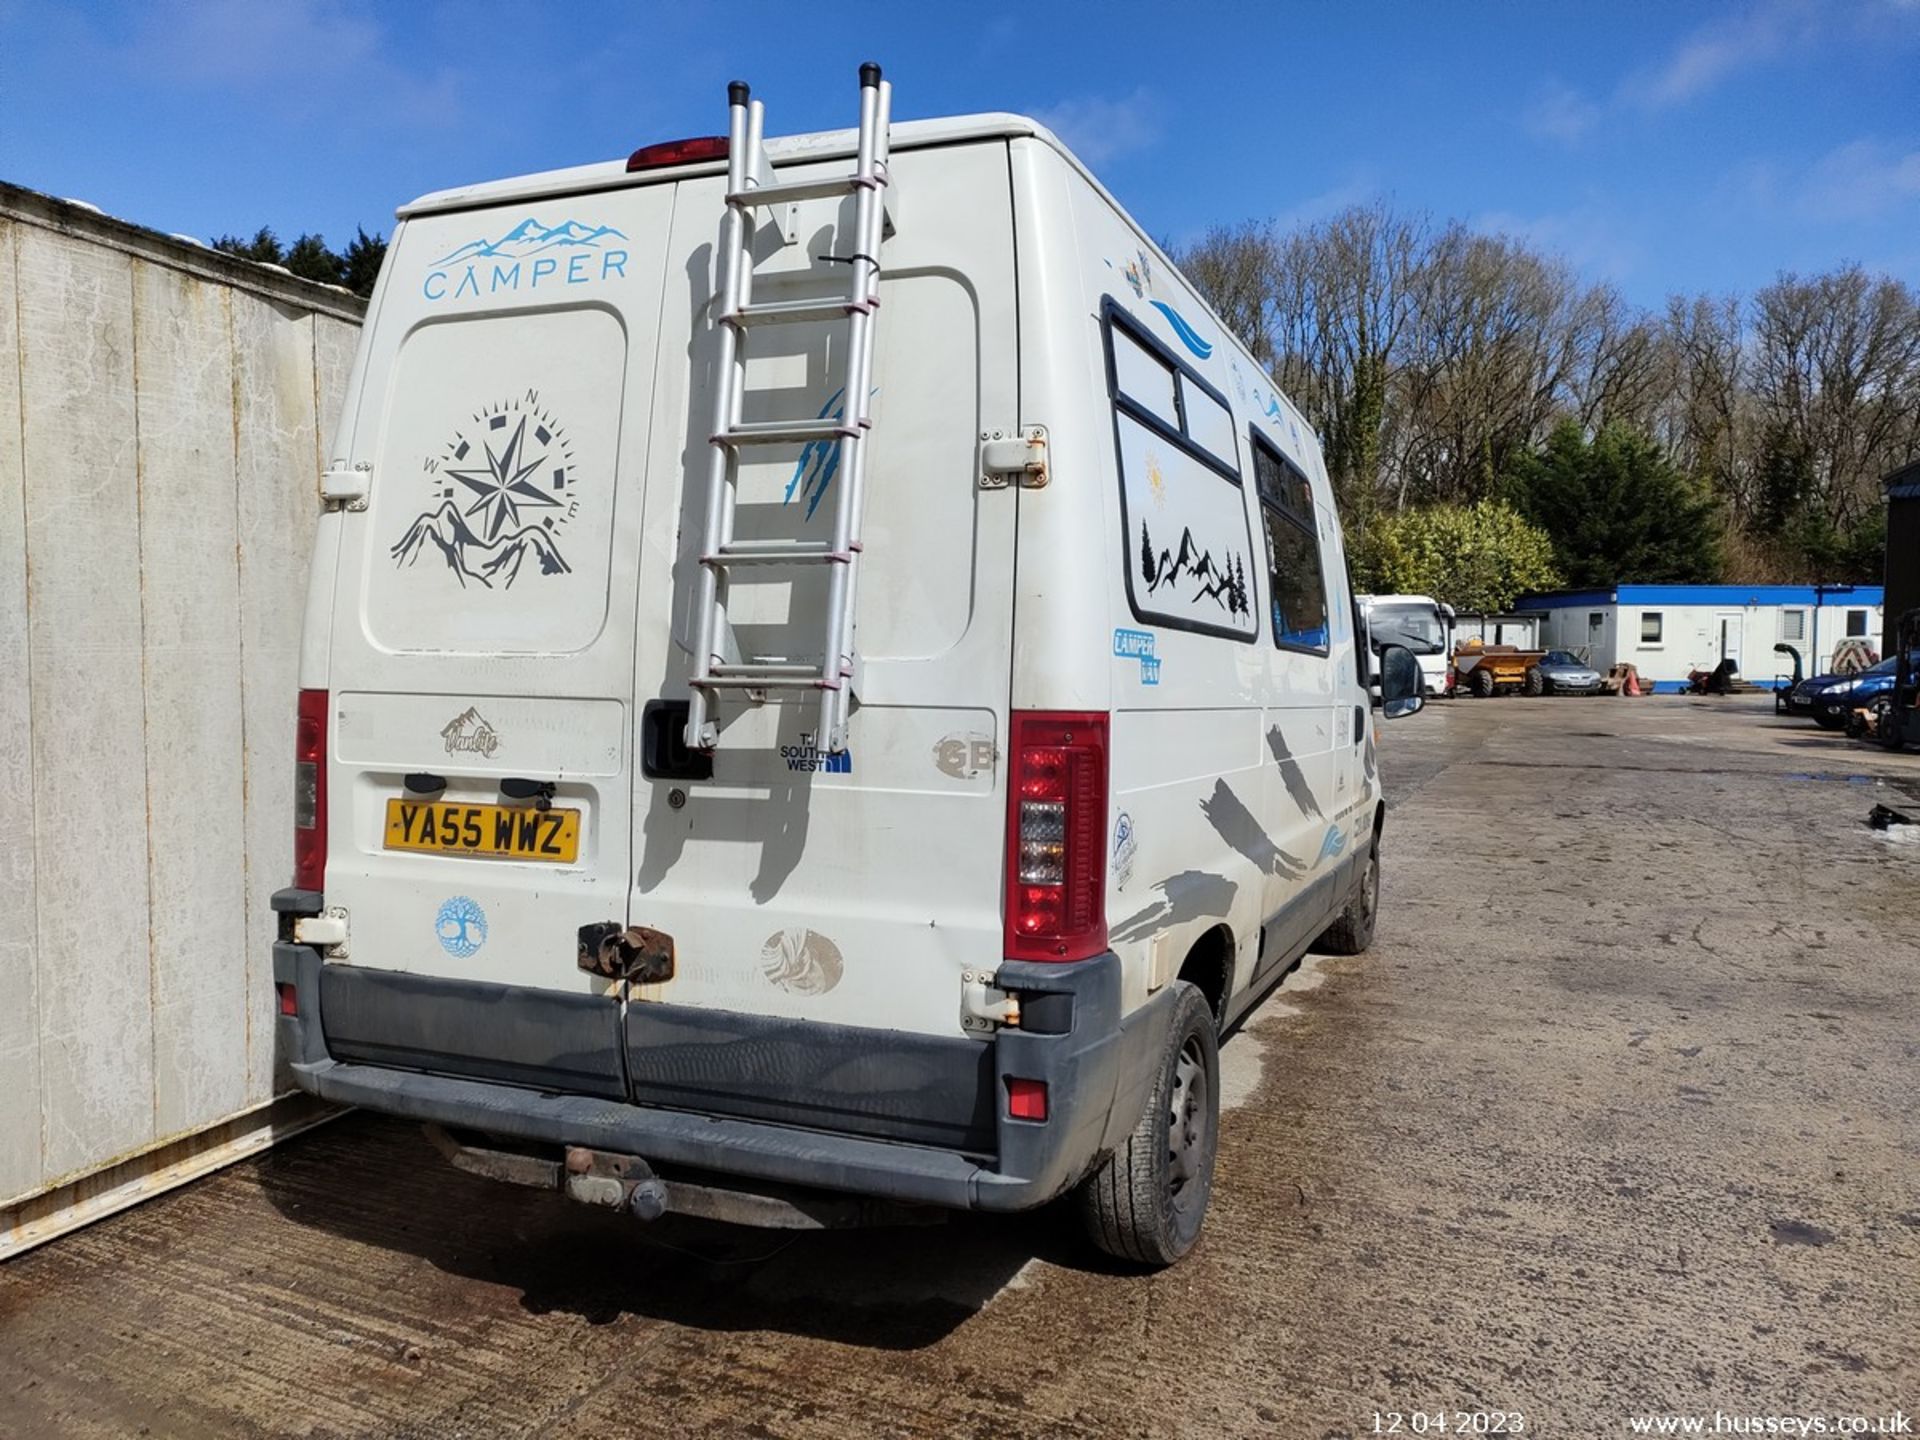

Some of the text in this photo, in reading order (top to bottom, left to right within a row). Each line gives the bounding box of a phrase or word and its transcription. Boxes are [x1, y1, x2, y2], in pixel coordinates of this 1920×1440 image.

[423, 250, 629, 300] CAMPER
[525, 388, 539, 404] N
[568, 501, 580, 518] E
[1114, 631, 1154, 657] CAMPER
[787, 758, 825, 773] WEST
[938, 739, 993, 773] GB
[400, 804, 564, 854] YA55 WWZ
